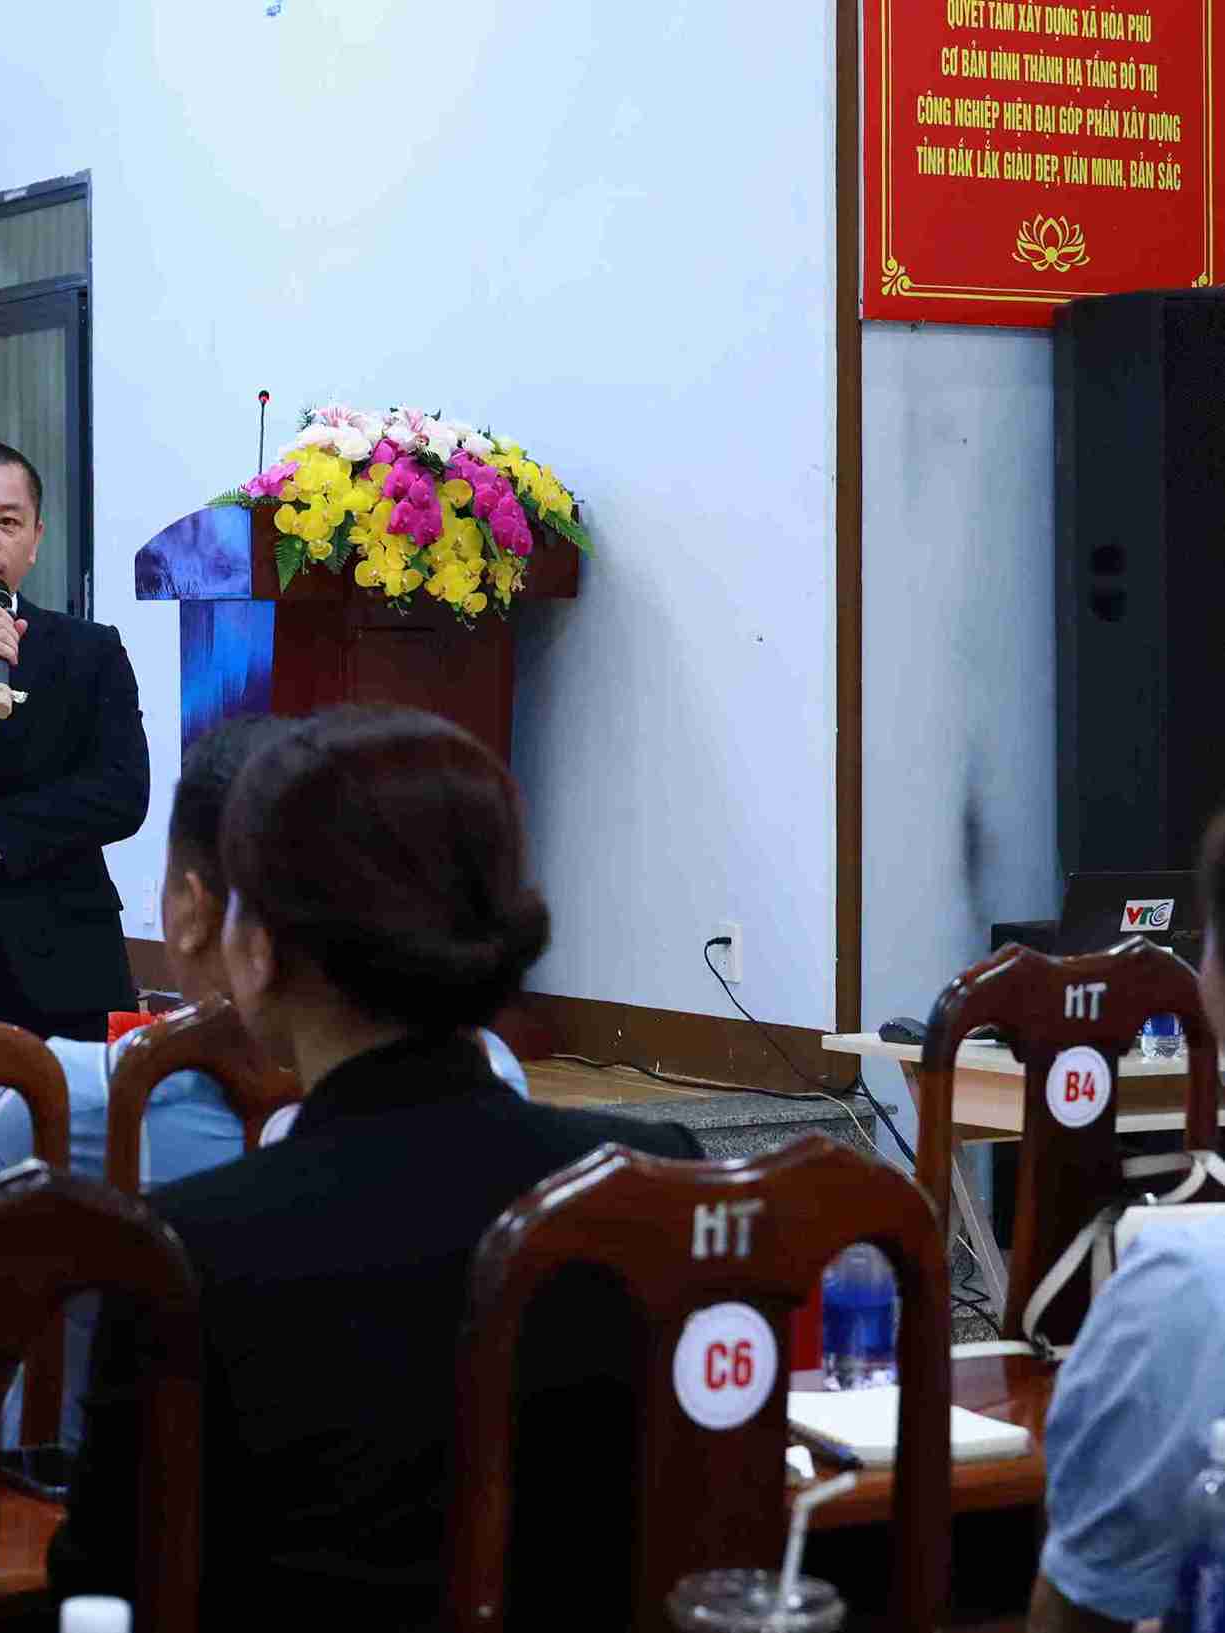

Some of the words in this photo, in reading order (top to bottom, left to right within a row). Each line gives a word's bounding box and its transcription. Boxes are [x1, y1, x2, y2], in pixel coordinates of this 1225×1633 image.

[1018, 0, 1042, 33] XÂY
[1046, 6, 1078, 41] DỰNG
[1082, 5, 1098, 38] XÃ
[1101, 4, 1125, 41] HÒA
[1128, 9, 1152, 43] PHÚ
[941, 45, 958, 76] CƠ
[961, 40, 987, 79] BẢN
[990, 46, 1020, 81] HÌNH
[1023, 49, 1063, 85] THÀNH
[1067, 57, 1082, 93] HẠ
[1120, 57, 1136, 91] ĐÔ
[1139, 63, 1158, 98] THỊ
[916, 89, 952, 126] CÔNG
[954, 94, 1000, 136] NGHIỆP
[1003, 96, 1032, 138] HIỆN
[1035, 104, 1056, 139] ĐẠI
[1059, 100, 1083, 135] GÓP
[1122, 105, 1145, 140] XÂY
[1148, 112, 1181, 148] DỰNG
[916, 136, 945, 176] TỈNH
[1003, 146, 1032, 181] GIÀU
[1063, 151, 1088, 185] VĂN
[1130, 151, 1155, 189] BẢN
[1126, 903, 1170, 927] VTC
[1063, 1071, 1096, 1103] B4
[704, 1341, 754, 1392] C6
